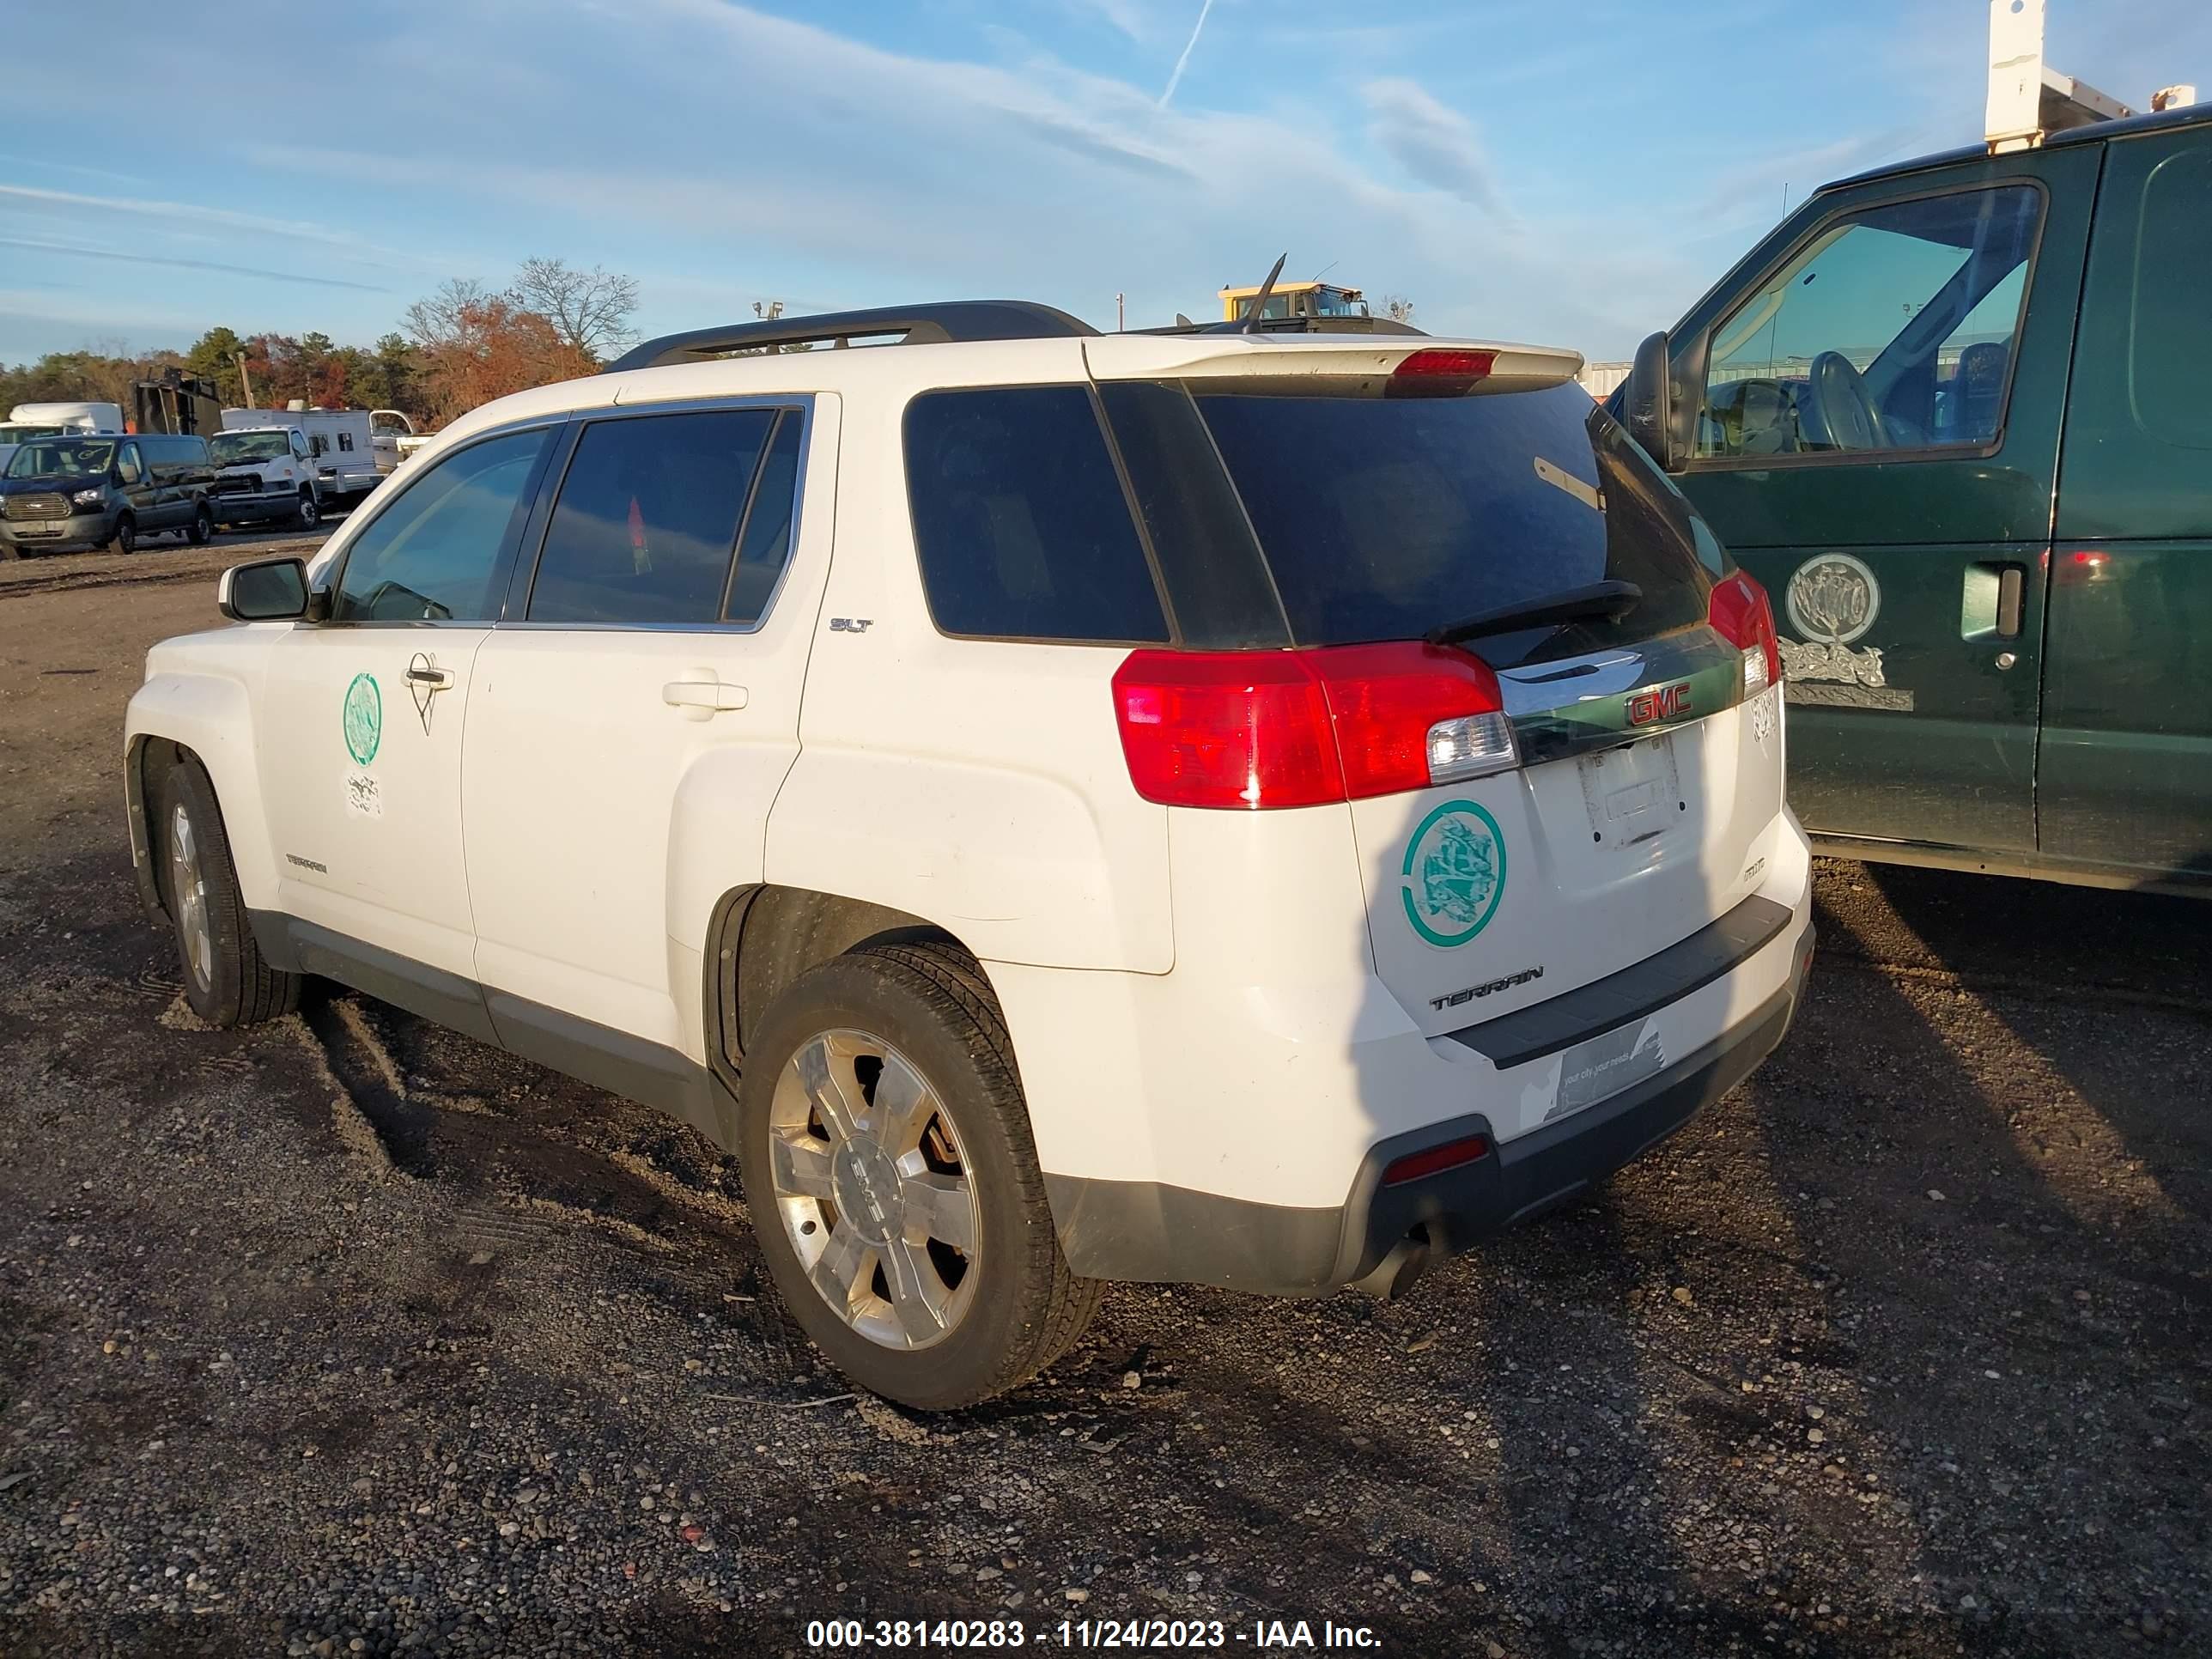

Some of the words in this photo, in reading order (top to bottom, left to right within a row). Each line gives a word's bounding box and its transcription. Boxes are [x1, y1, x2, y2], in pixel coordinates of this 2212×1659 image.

[830, 617, 874, 634] SLT
[1626, 683, 1692, 727] GMC
[1429, 963, 1545, 1012] TERRAIN
[850, 1157, 884, 1223] GMC
